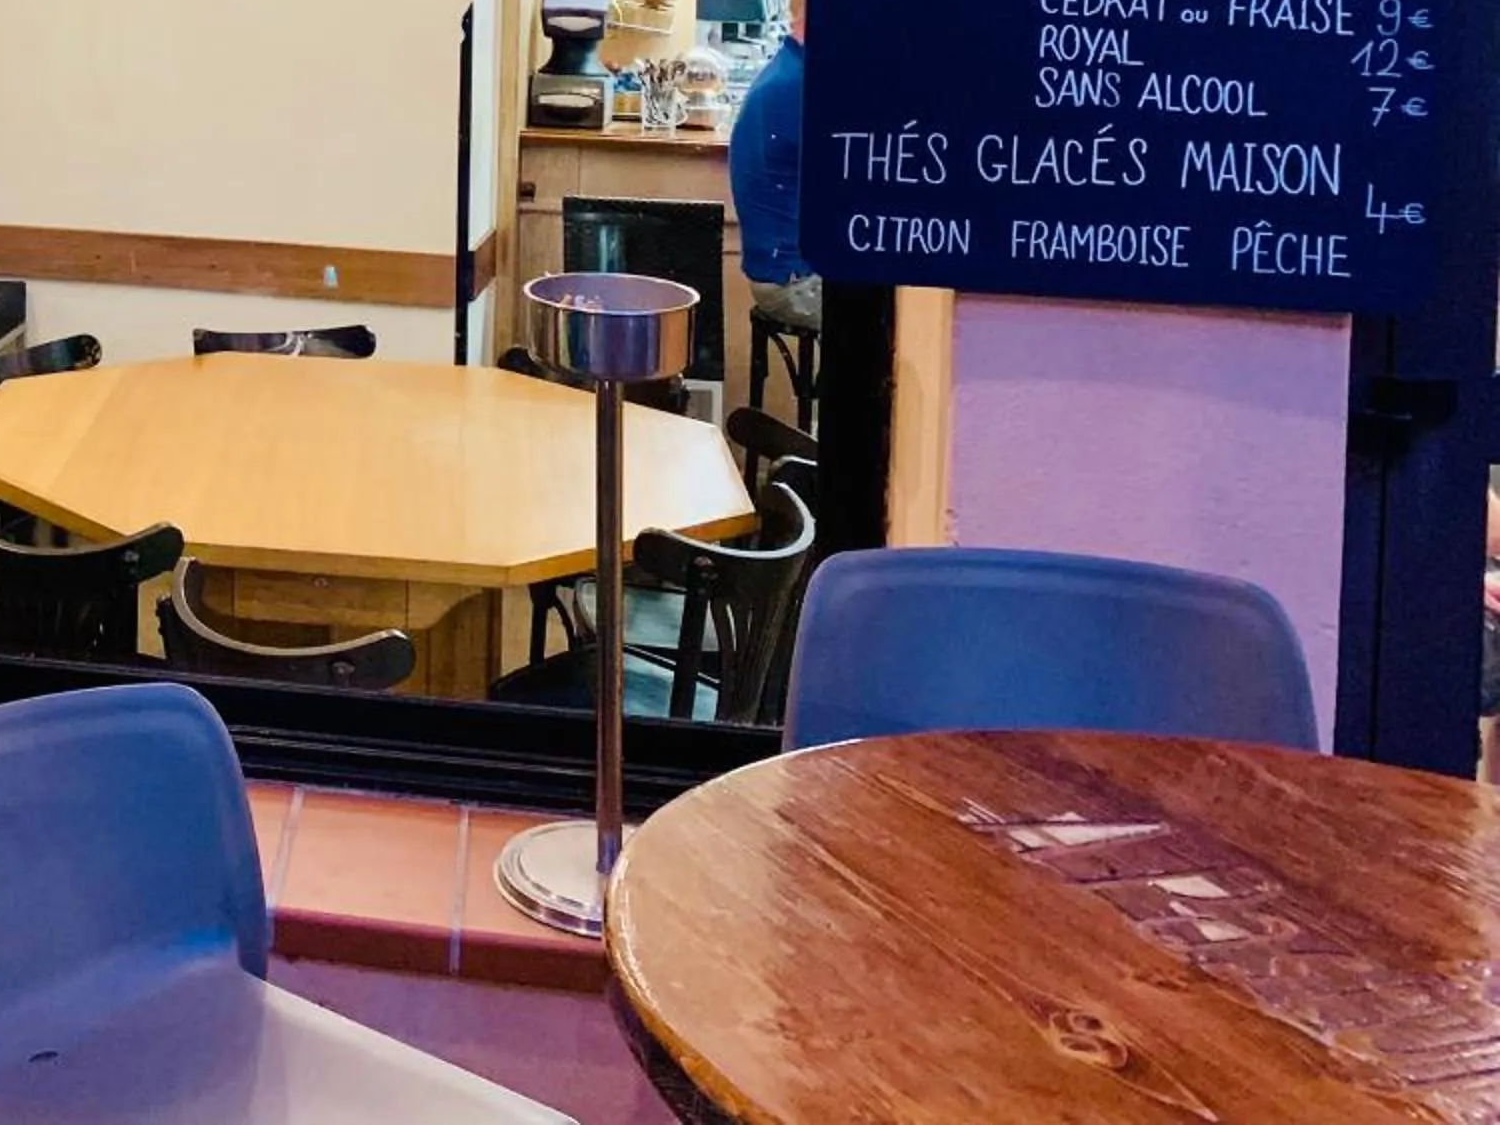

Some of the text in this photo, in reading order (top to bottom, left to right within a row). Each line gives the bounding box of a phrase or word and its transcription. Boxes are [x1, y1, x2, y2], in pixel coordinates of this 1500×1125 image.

[1039, 25, 1144, 66] ROYAL
[1035, 67, 1121, 109] SANS
[1138, 75, 1267, 117] ALCOOL
[833, 120, 1341, 196] THÉS GLACÉS MAISON
[848, 214, 1351, 278] CITRON FRAMBOISE PÊCHE
